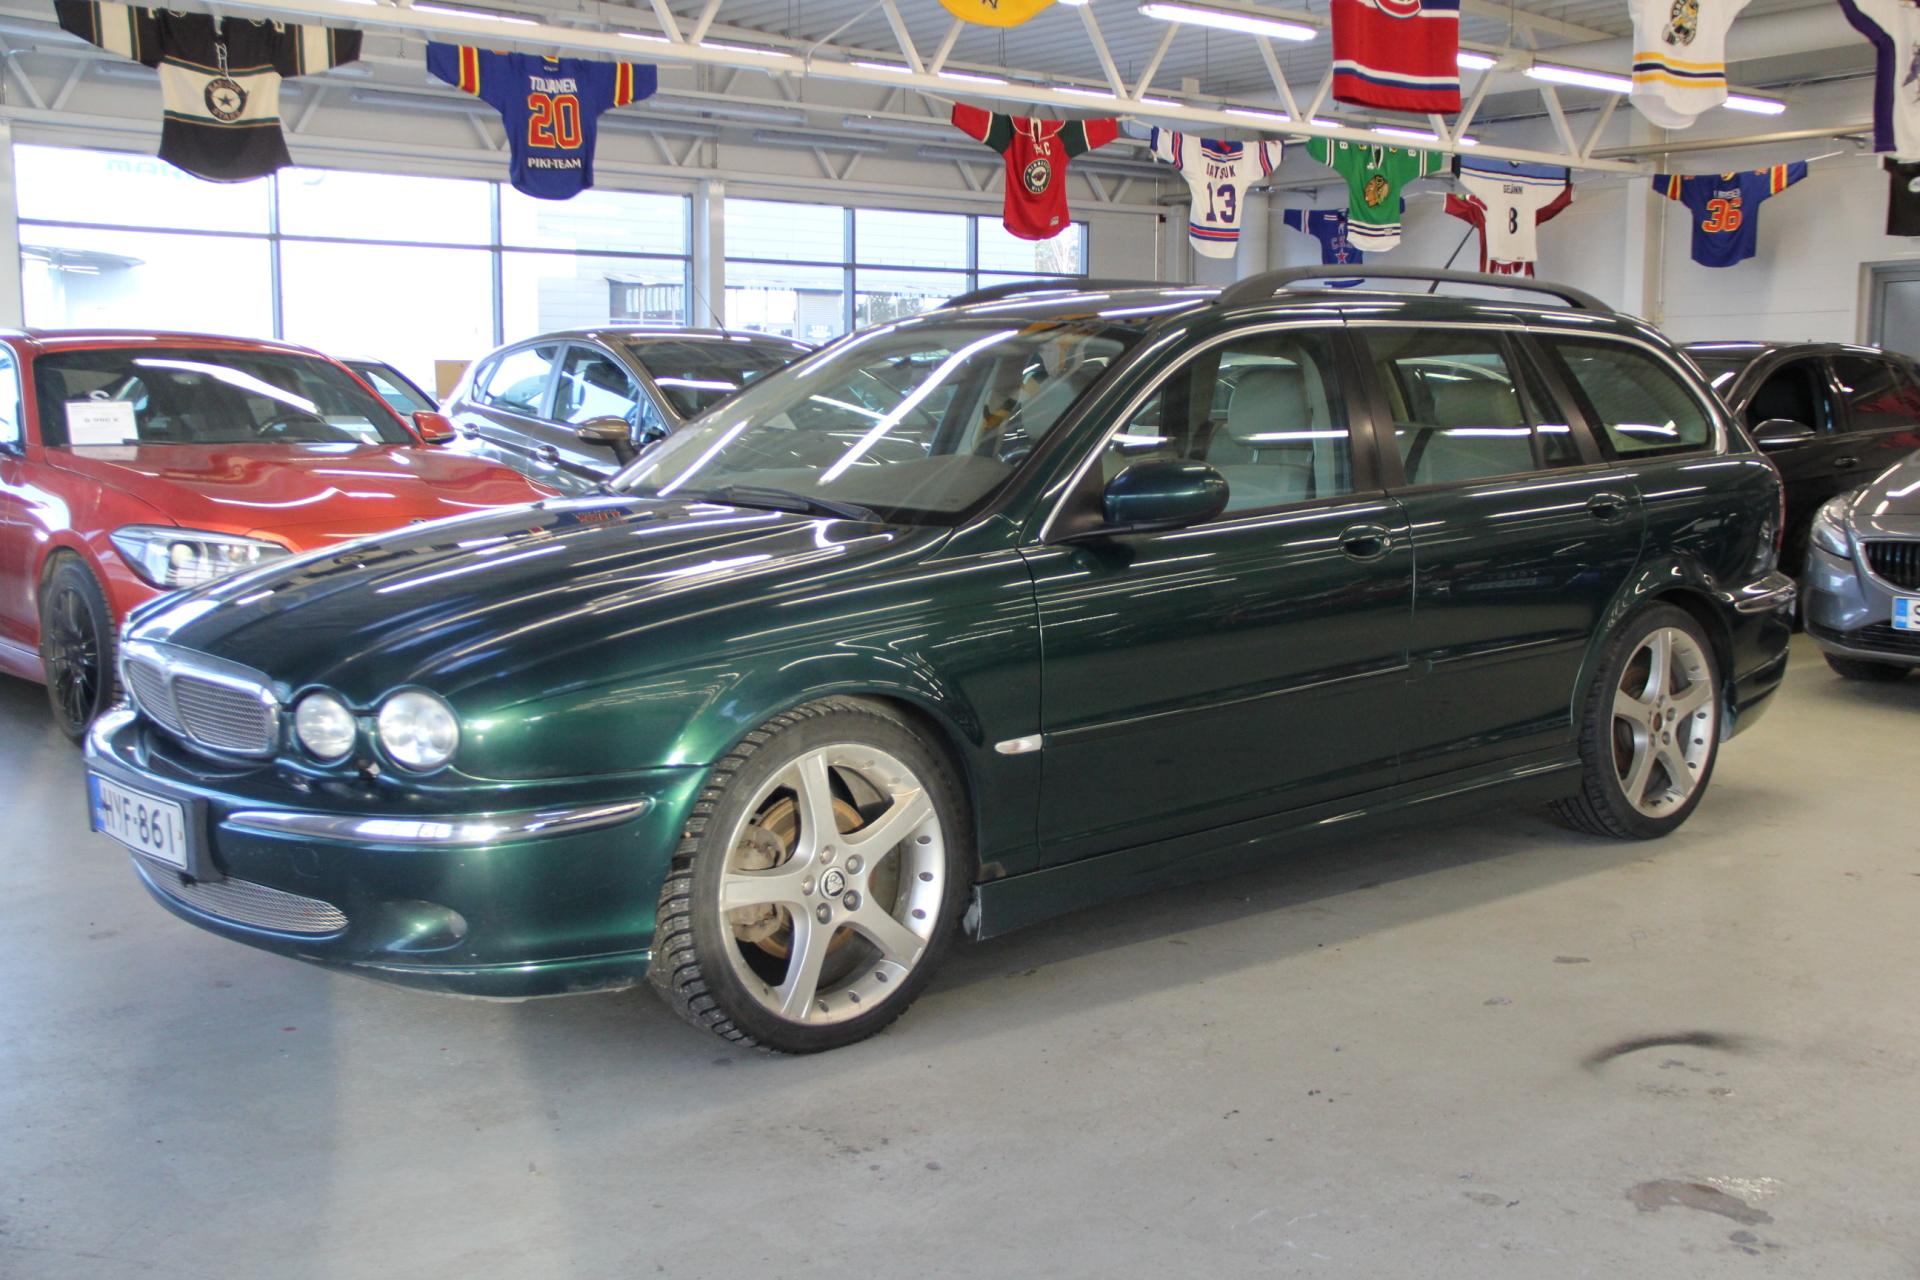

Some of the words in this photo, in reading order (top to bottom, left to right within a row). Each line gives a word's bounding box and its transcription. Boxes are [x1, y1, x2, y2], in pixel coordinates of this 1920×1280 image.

[527, 92, 582, 149] 20
[1206, 181, 1237, 224] 13
[1701, 198, 1743, 232] 36
